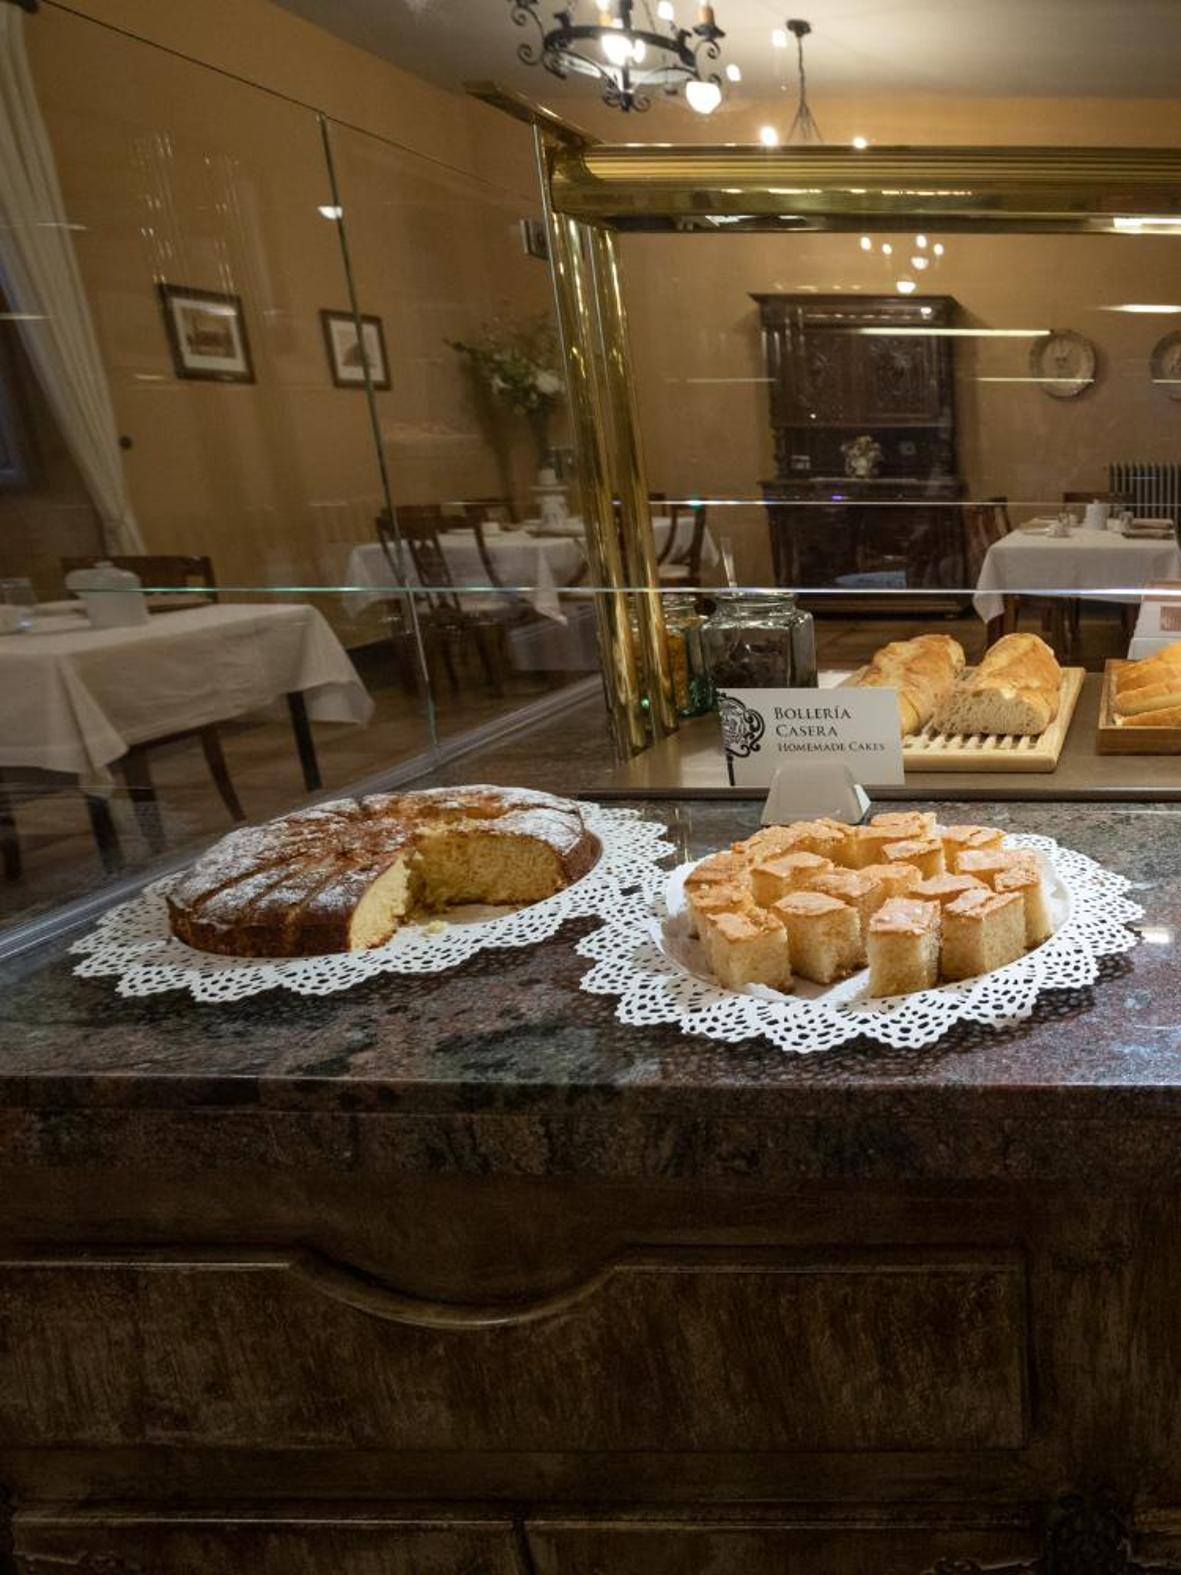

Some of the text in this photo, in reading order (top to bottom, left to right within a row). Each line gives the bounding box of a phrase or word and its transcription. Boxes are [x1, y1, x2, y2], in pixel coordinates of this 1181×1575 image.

[774, 705, 851, 720] BOLLERÍA
[775, 724, 838, 738] CASERA
[778, 741, 886, 752] HOMEMADE CAKES
